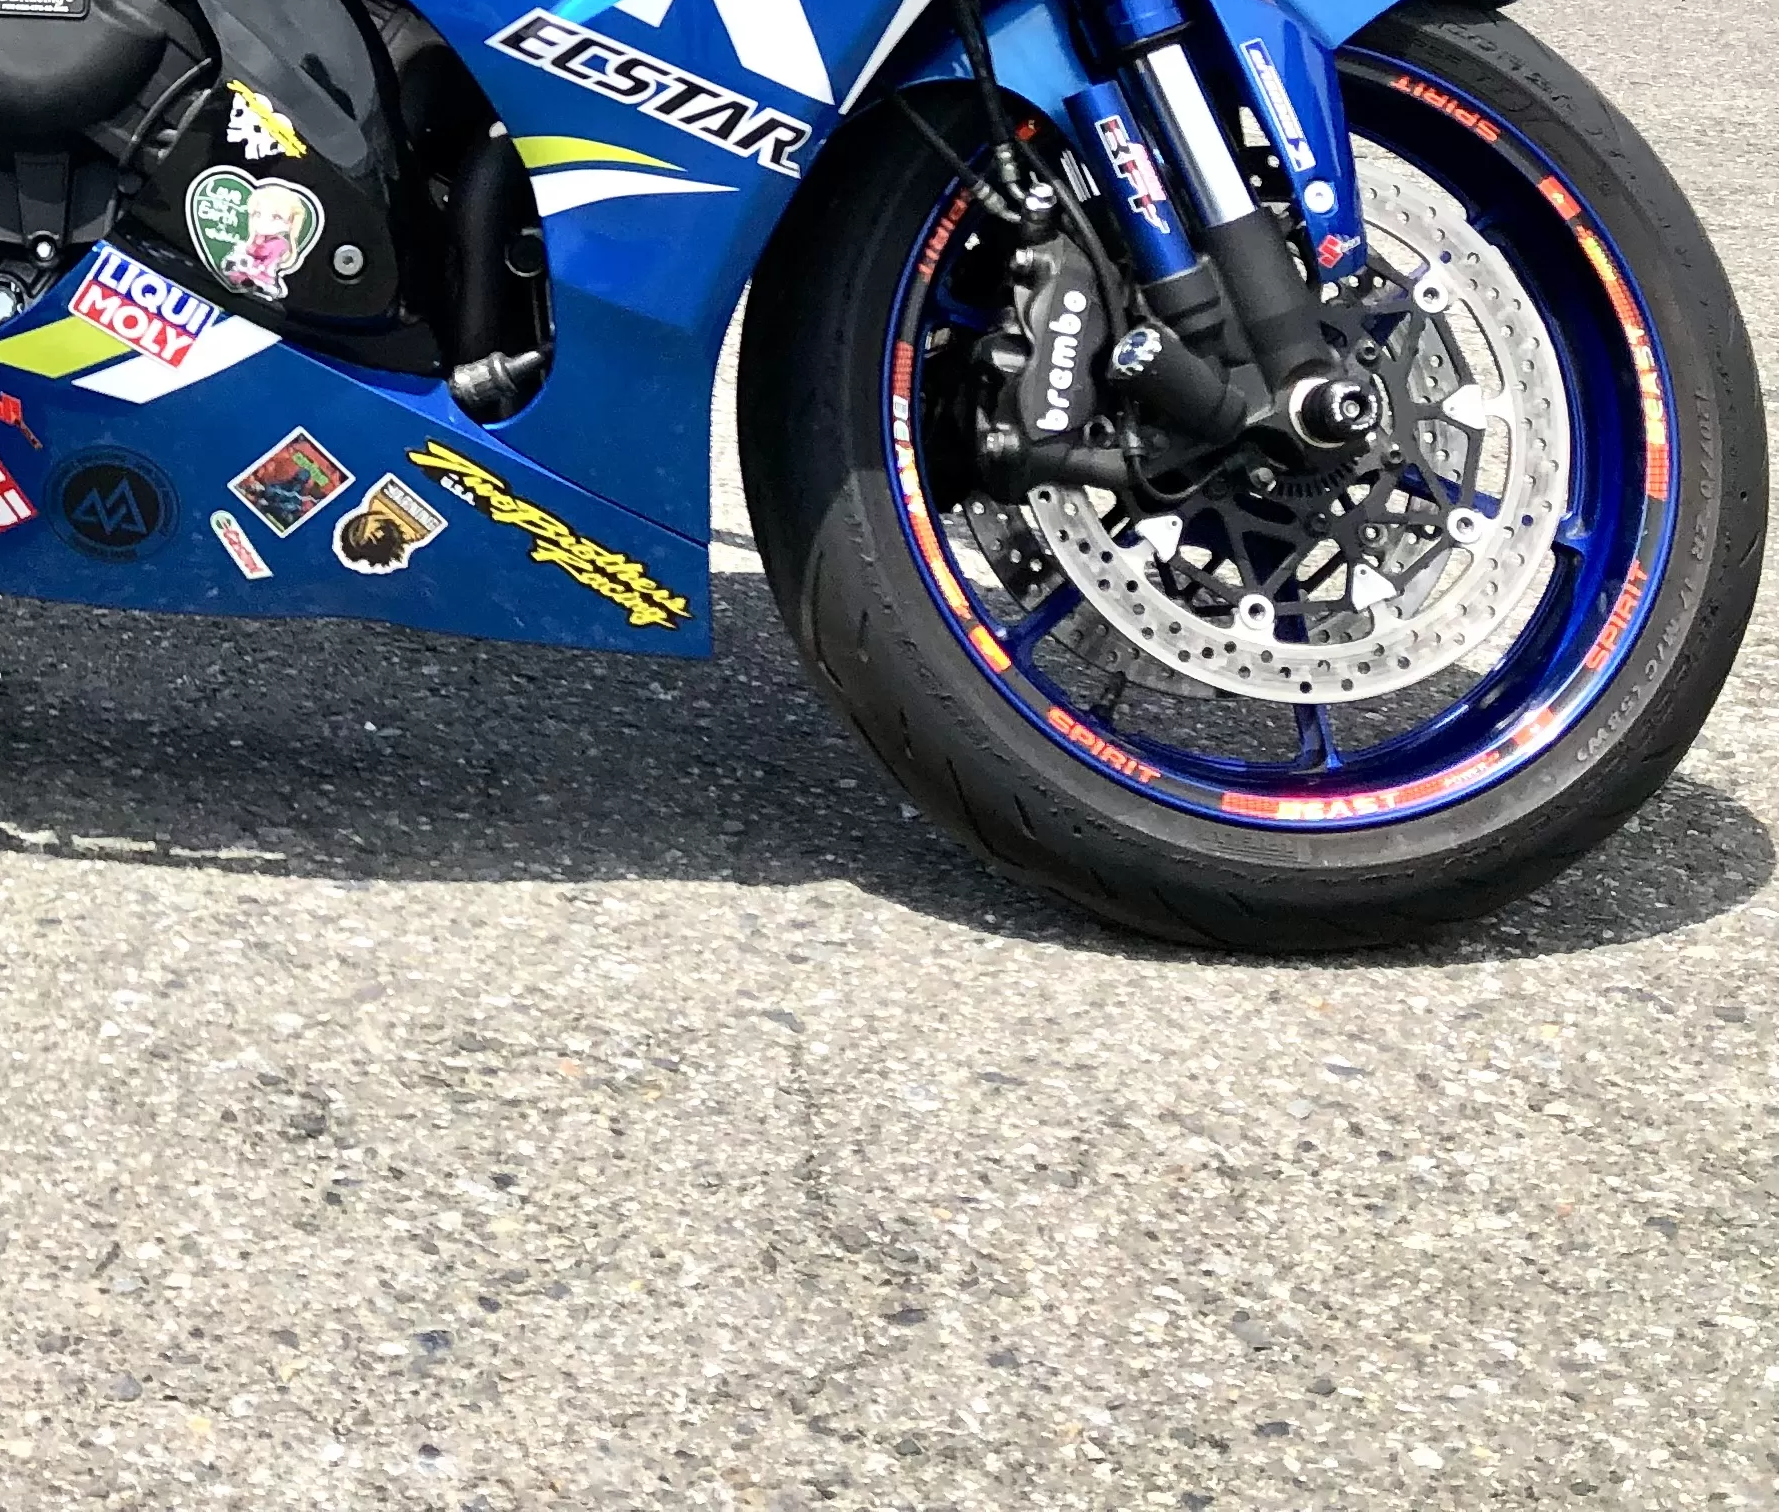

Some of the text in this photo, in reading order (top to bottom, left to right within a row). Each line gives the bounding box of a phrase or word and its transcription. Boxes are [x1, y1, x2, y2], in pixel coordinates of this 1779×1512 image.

[493, 10, 811, 177] ECSTAR
[1390, 76, 1499, 145] SPIRIT
[79, 290, 197, 360] MOLY
[101, 256, 206, 329] LIQUI
[1037, 290, 1087, 431] brembo
[408, 439, 523, 514] Two
[530, 538, 678, 629] Racing
[1586, 560, 1648, 670] SPIRIT
[1047, 707, 1161, 785] SPIRIT
[1277, 791, 1399, 821] BEAST
